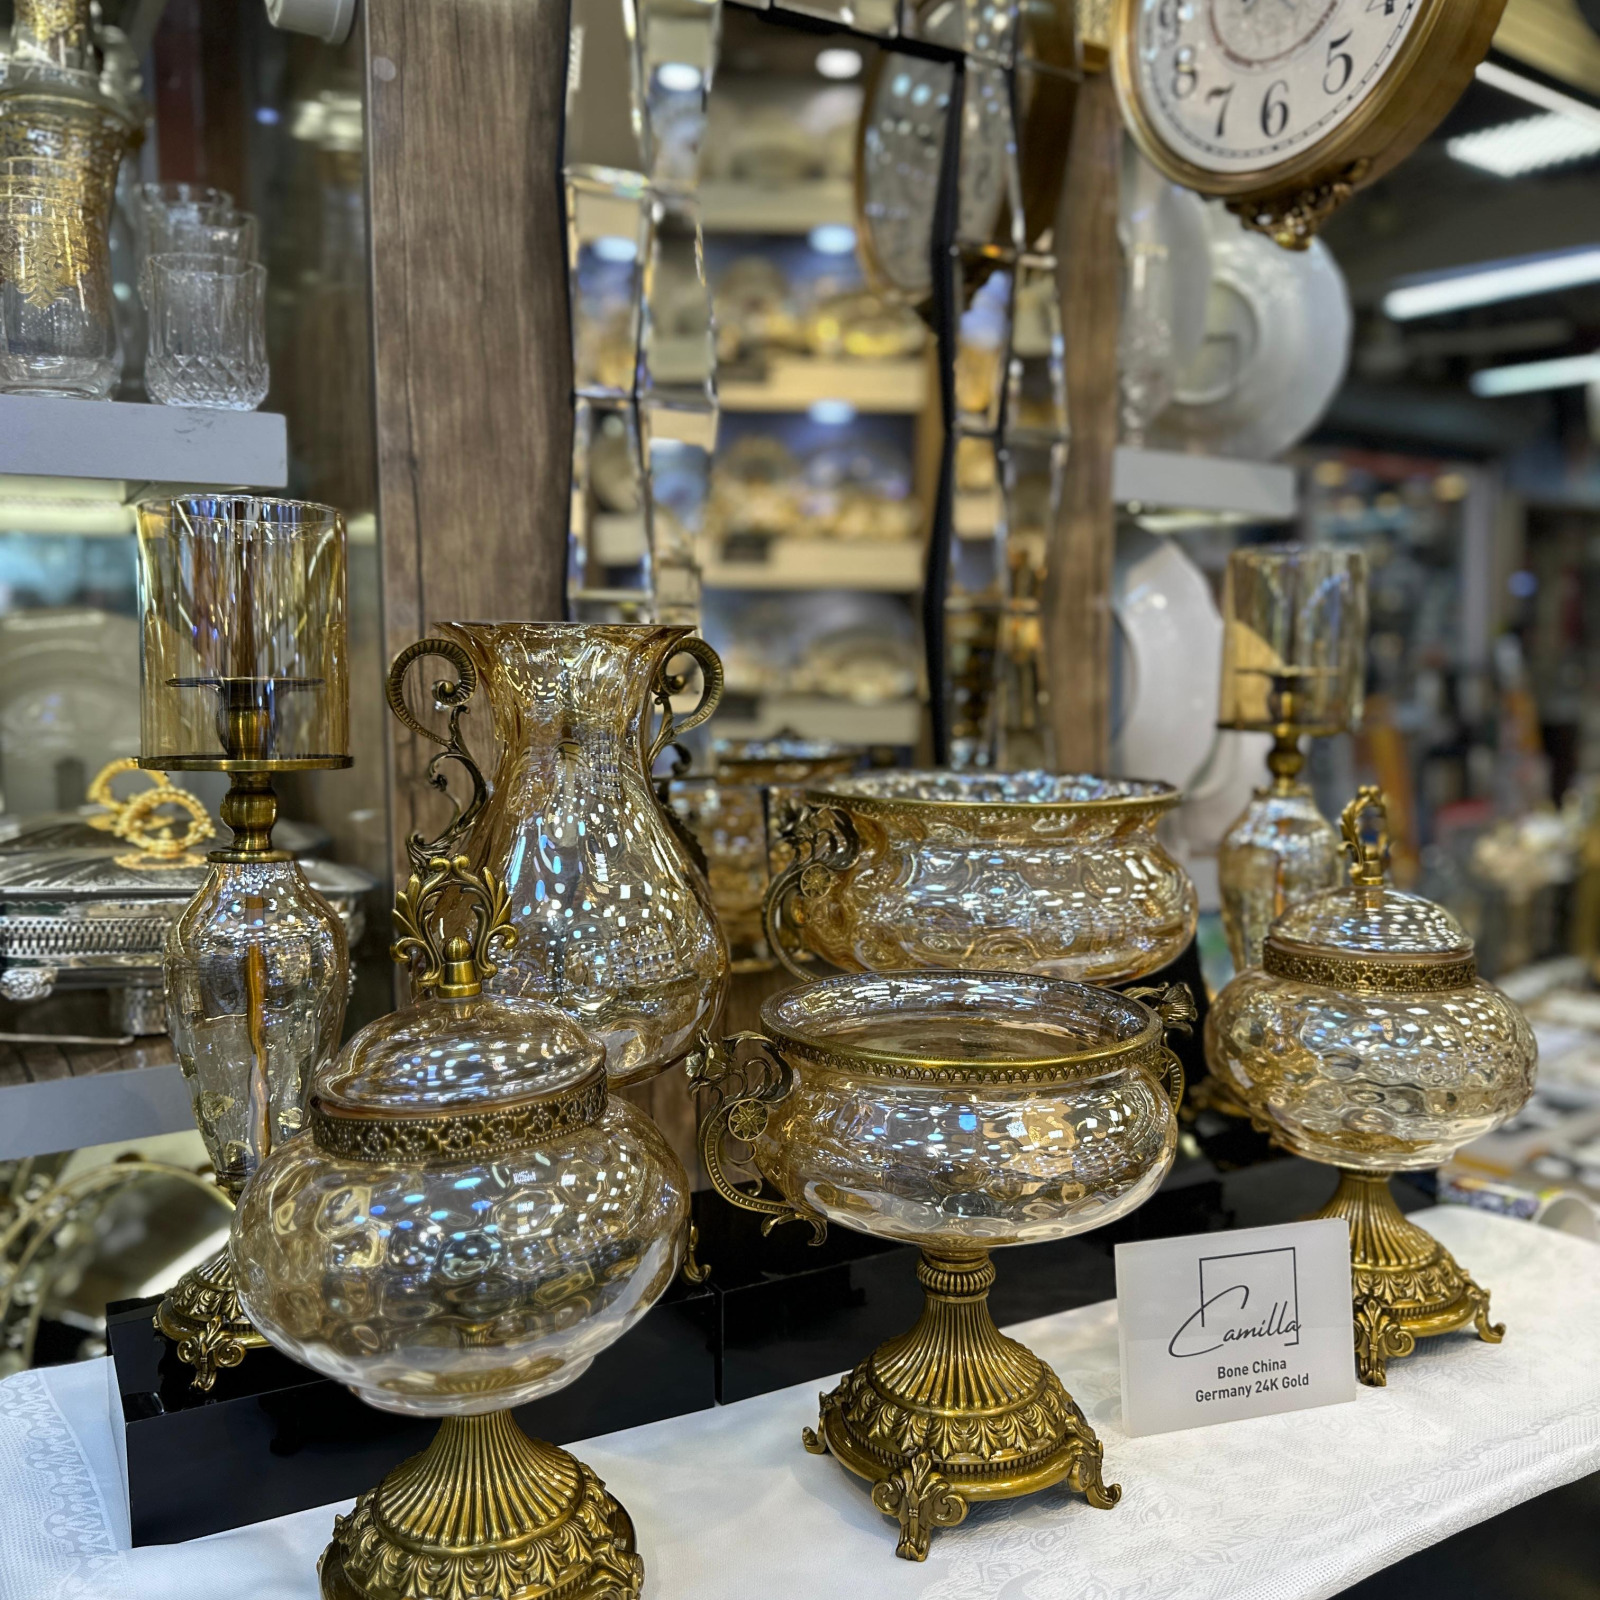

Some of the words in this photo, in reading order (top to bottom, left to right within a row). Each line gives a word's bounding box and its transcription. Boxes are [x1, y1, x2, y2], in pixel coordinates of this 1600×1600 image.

[1172, 45, 1198, 99] 8
[1322, 28, 1354, 96] 5
[1206, 82, 1235, 139] 7
[1260, 79, 1290, 139] 6
[1168, 1284, 1302, 1358] Camilla
[1195, 1384, 1252, 1403] Germany
[1255, 1377, 1279, 1394] 24K
[1282, 1373, 1309, 1389] Gold
[1217, 1365, 1249, 1380] Bone
[1252, 1359, 1287, 1374] China
